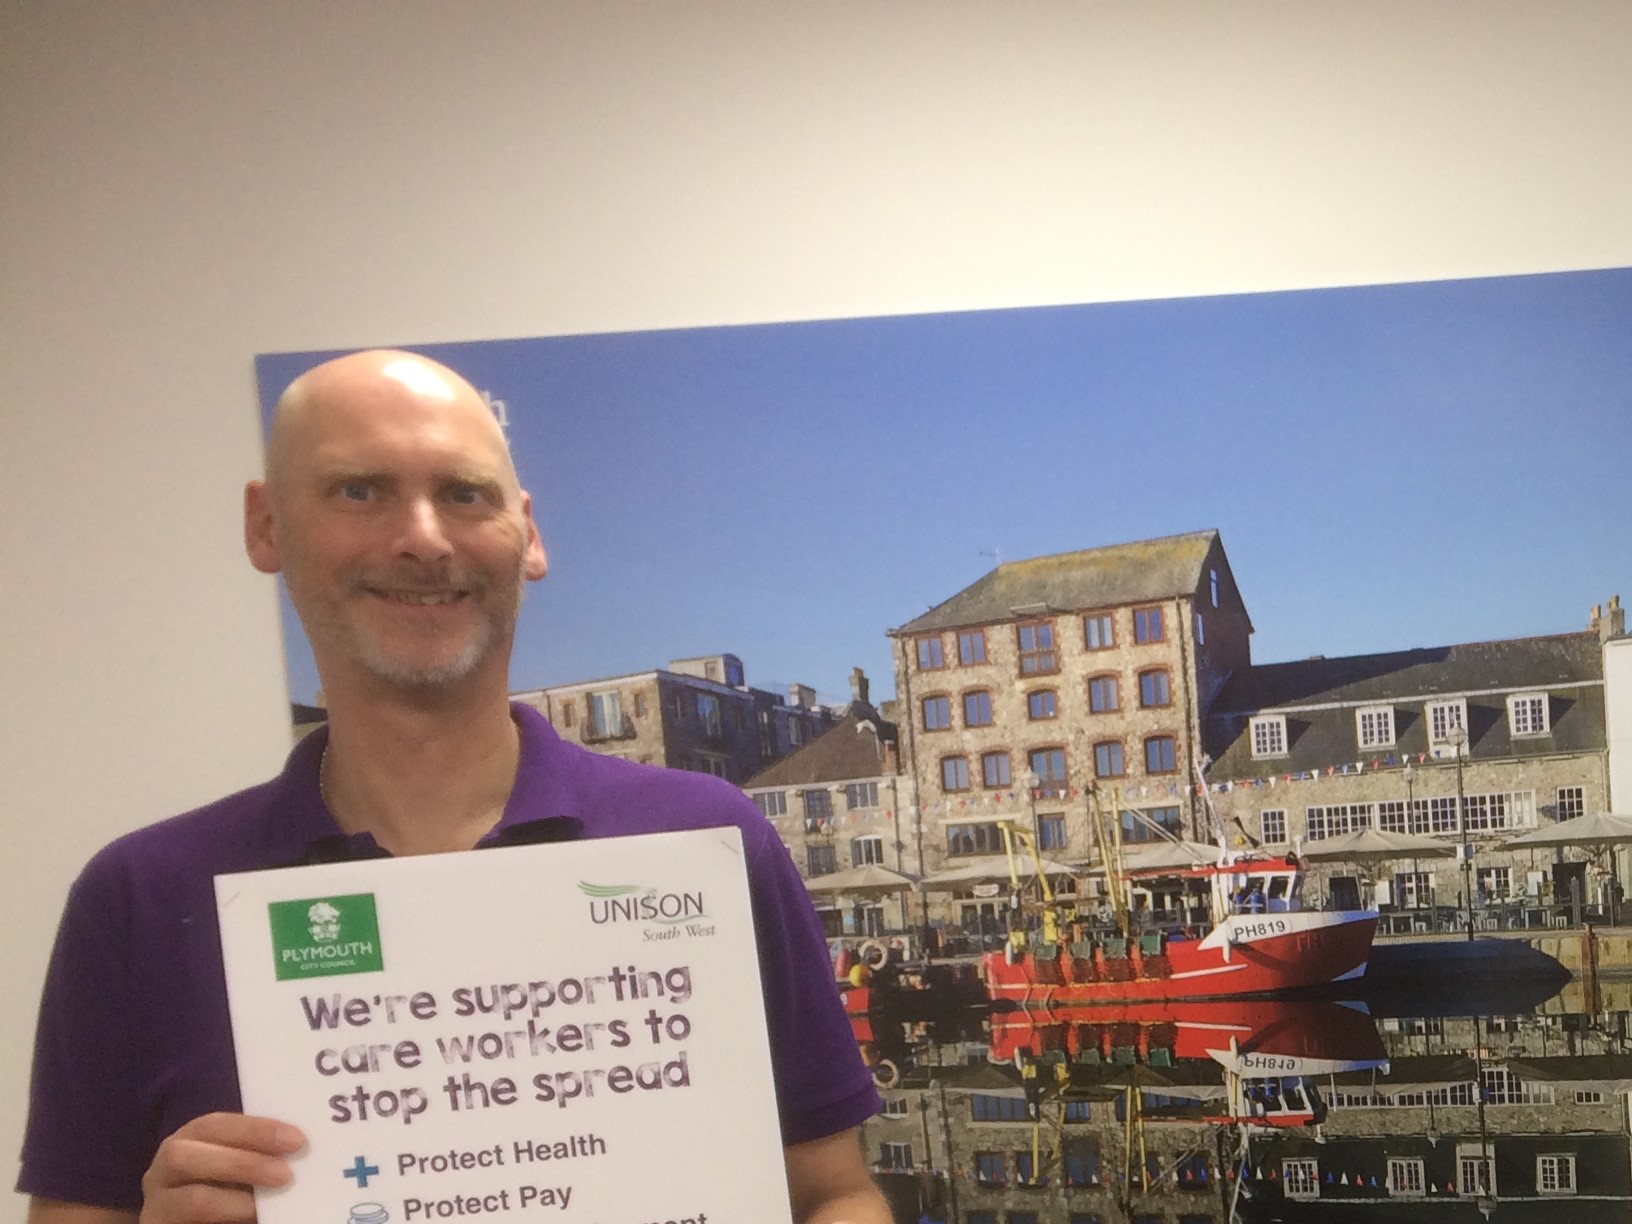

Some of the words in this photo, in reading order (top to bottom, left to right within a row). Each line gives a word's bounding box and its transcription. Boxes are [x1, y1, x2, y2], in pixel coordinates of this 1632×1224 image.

[590, 891, 703, 924] UNISON
[642, 925, 681, 942] South
[685, 924, 716, 938] West
[1233, 919, 1286, 942] PH819
[282, 941, 373, 962] PLYMOUTH
[299, 991, 438, 1031] We're
[452, 965, 692, 1021] supporting
[315, 1040, 422, 1077] care
[436, 1019, 631, 1063] workers
[644, 1009, 691, 1044] to
[328, 1085, 428, 1125] stop
[442, 1072, 518, 1112] the
[532, 1051, 691, 1109] spread
[397, 1144, 505, 1176] Protect
[513, 1133, 606, 1164] Health
[403, 1189, 510, 1222] Protect
[519, 1185, 572, 1211] Pay
